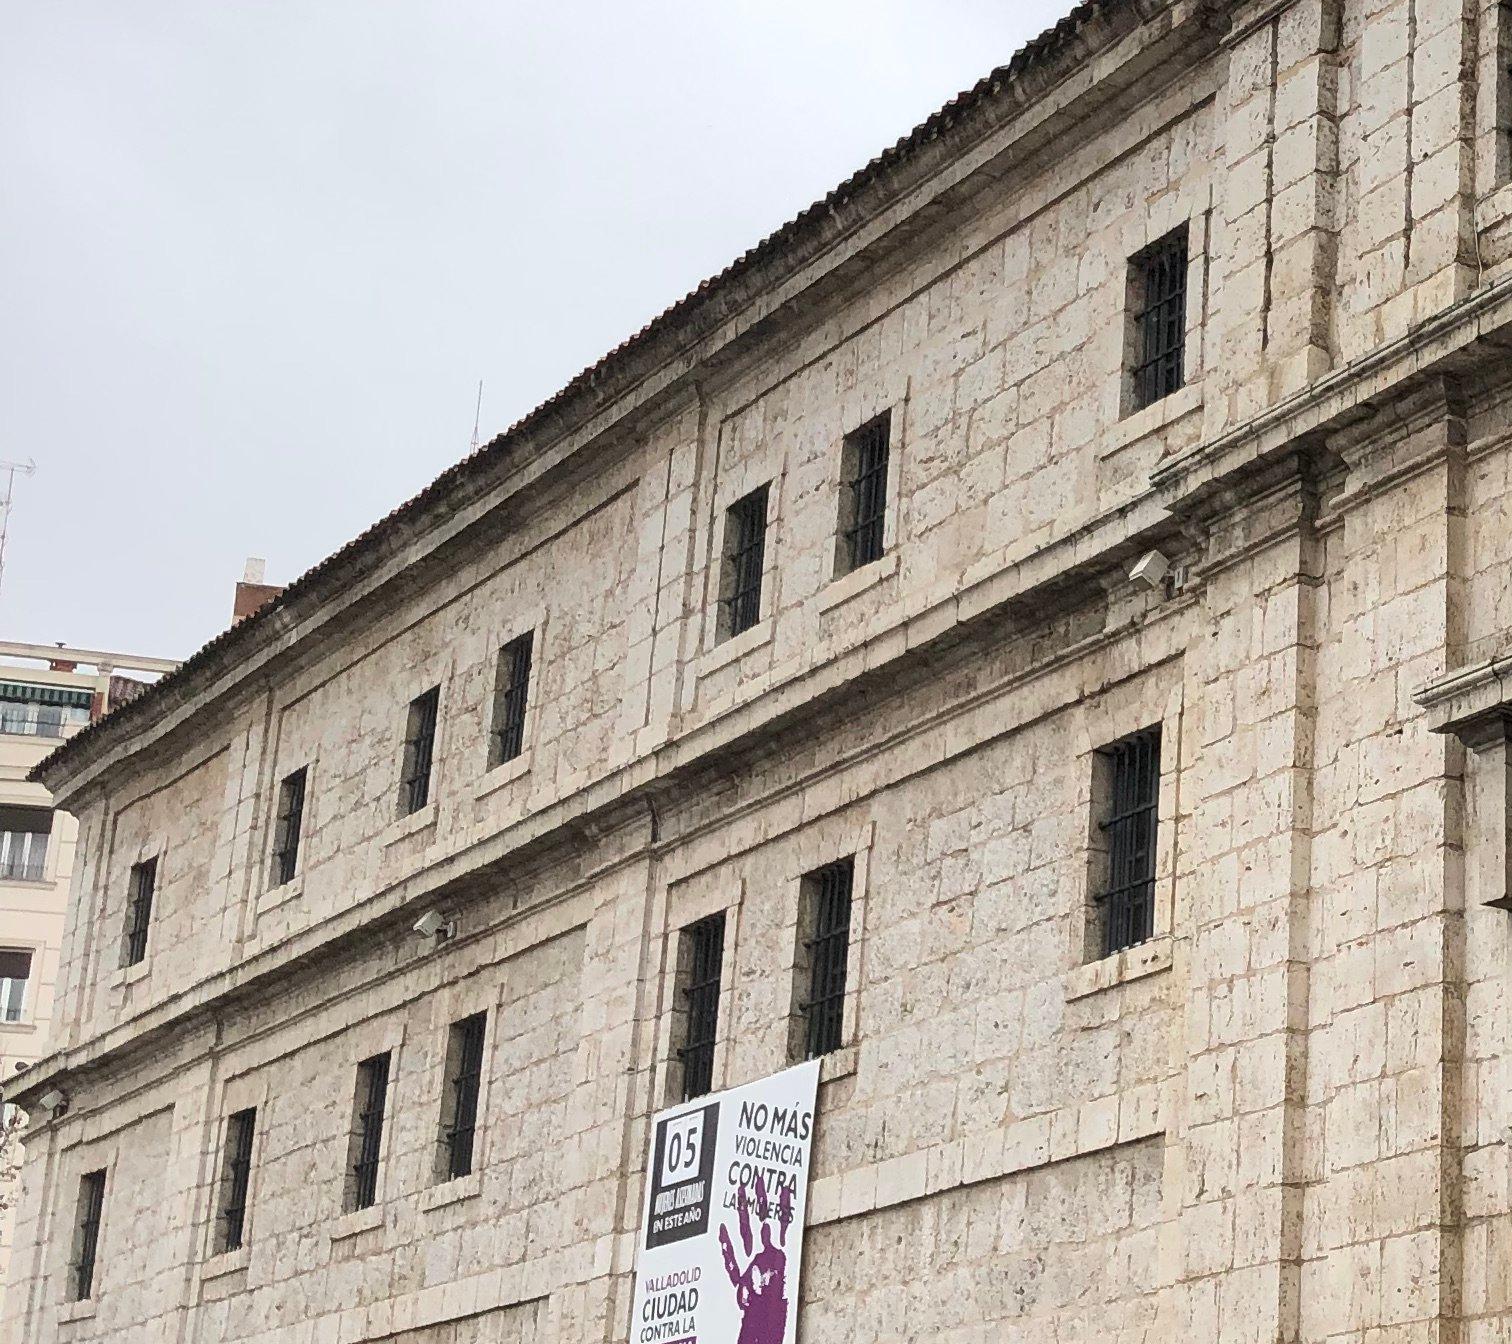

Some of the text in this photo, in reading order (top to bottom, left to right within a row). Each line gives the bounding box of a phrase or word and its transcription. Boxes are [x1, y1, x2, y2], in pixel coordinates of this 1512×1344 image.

[739, 1100, 812, 1141] NO MÁS
[668, 1126, 698, 1174] 05
[735, 1134, 803, 1168] VIOLENCIA
[728, 1160, 797, 1200] CONTRA
[664, 1212, 684, 1231] ESTE
[683, 1206, 702, 1225] AÑO
[723, 1190, 747, 1213] LA
[645, 1266, 701, 1293] VALLADOLID
[642, 1287, 699, 1323] CIUDAD
[640, 1315, 696, 1344] CONTRA LA
